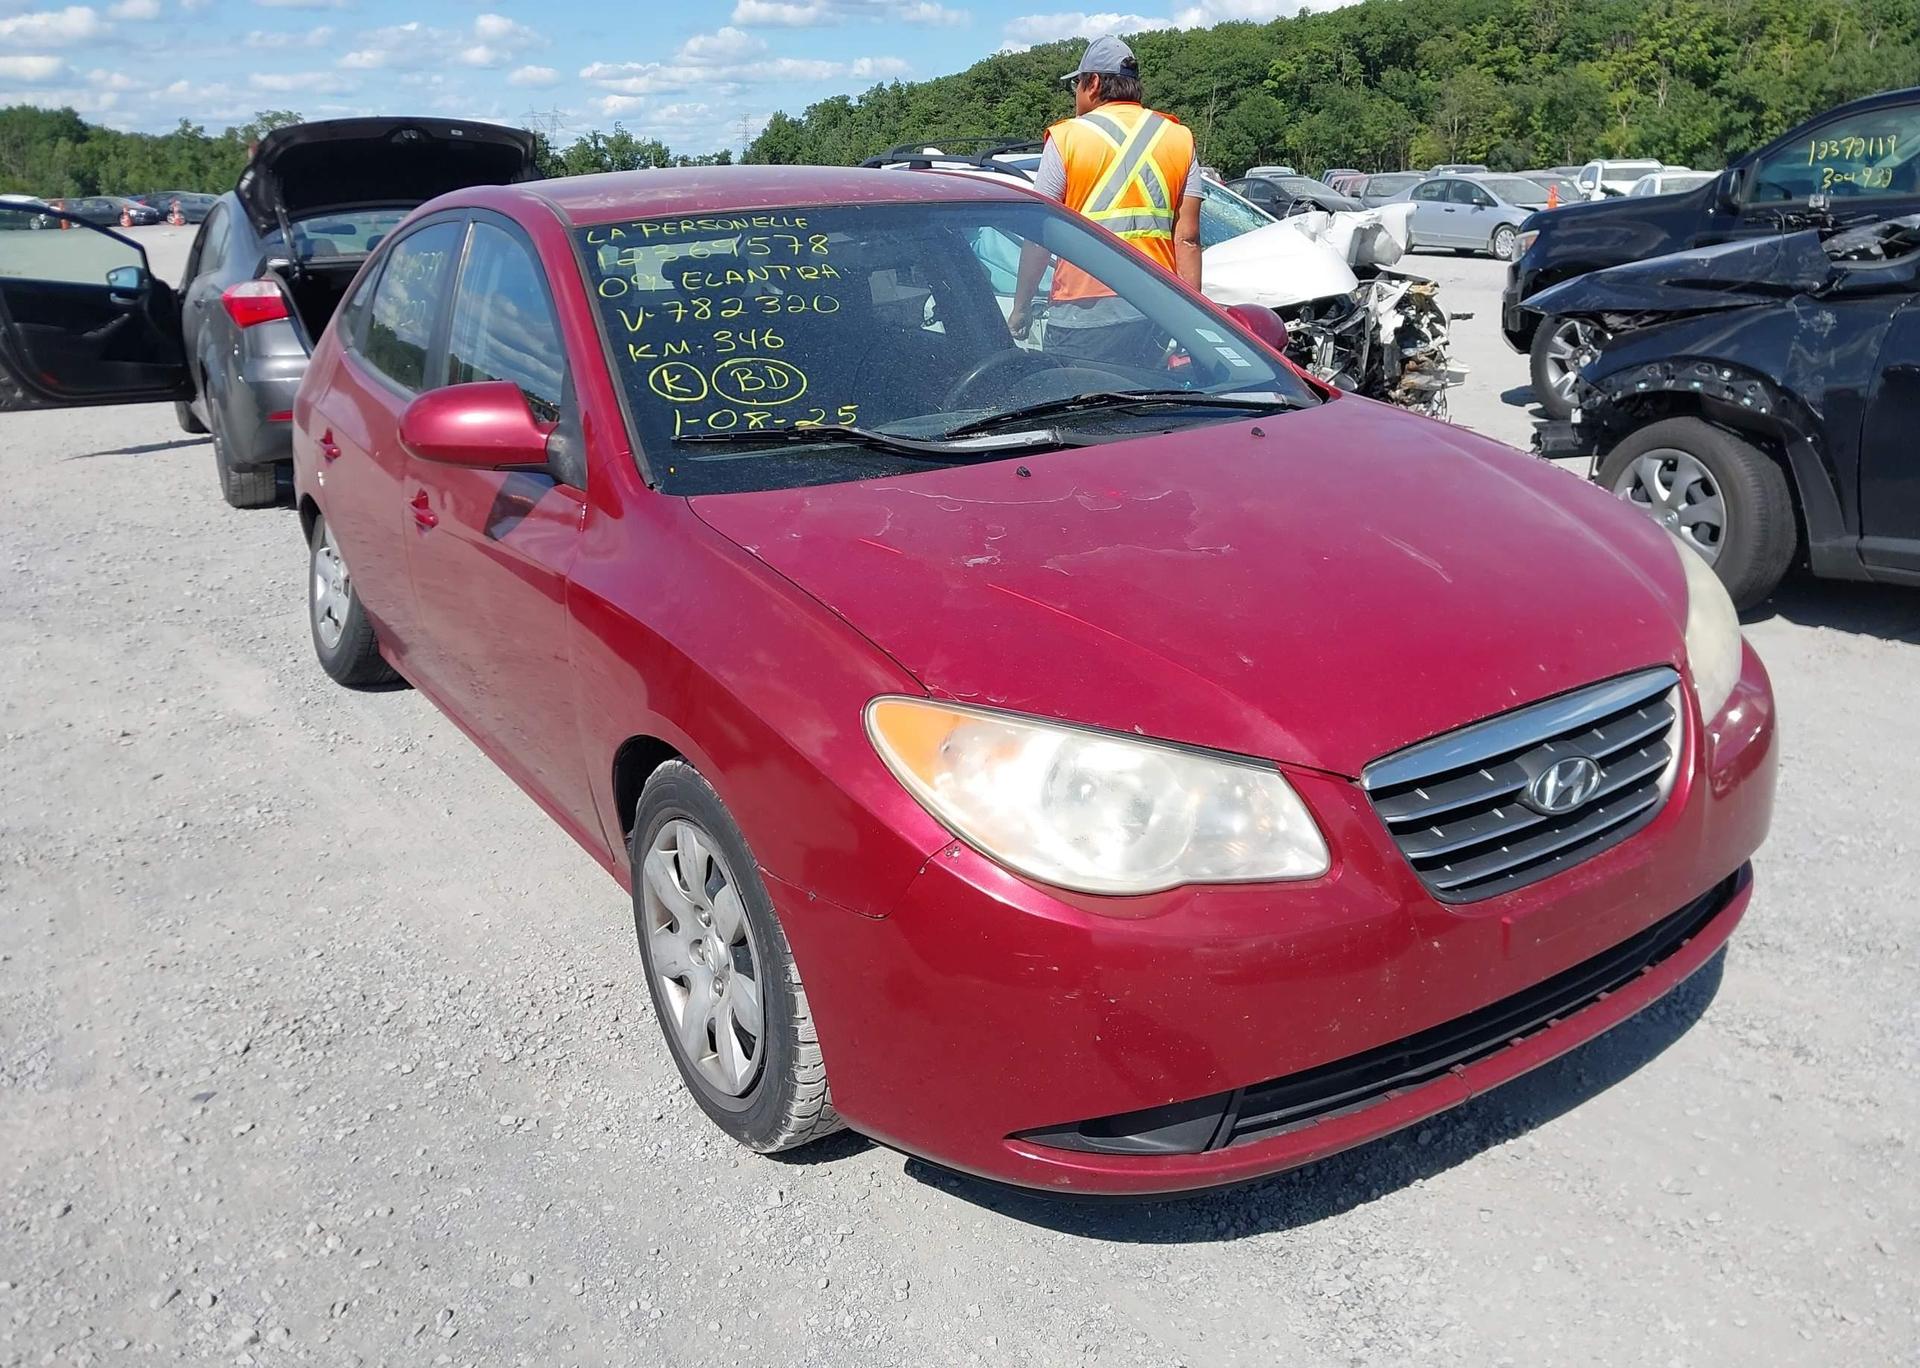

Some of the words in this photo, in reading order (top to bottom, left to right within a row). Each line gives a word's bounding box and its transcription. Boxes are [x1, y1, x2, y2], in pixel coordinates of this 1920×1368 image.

[587, 227, 626, 244] LA
[632, 216, 809, 239] PERSONELLE
[681, 263, 842, 290] ELANTRA
[661, 368, 692, 393] K
[729, 365, 790, 393] BD
